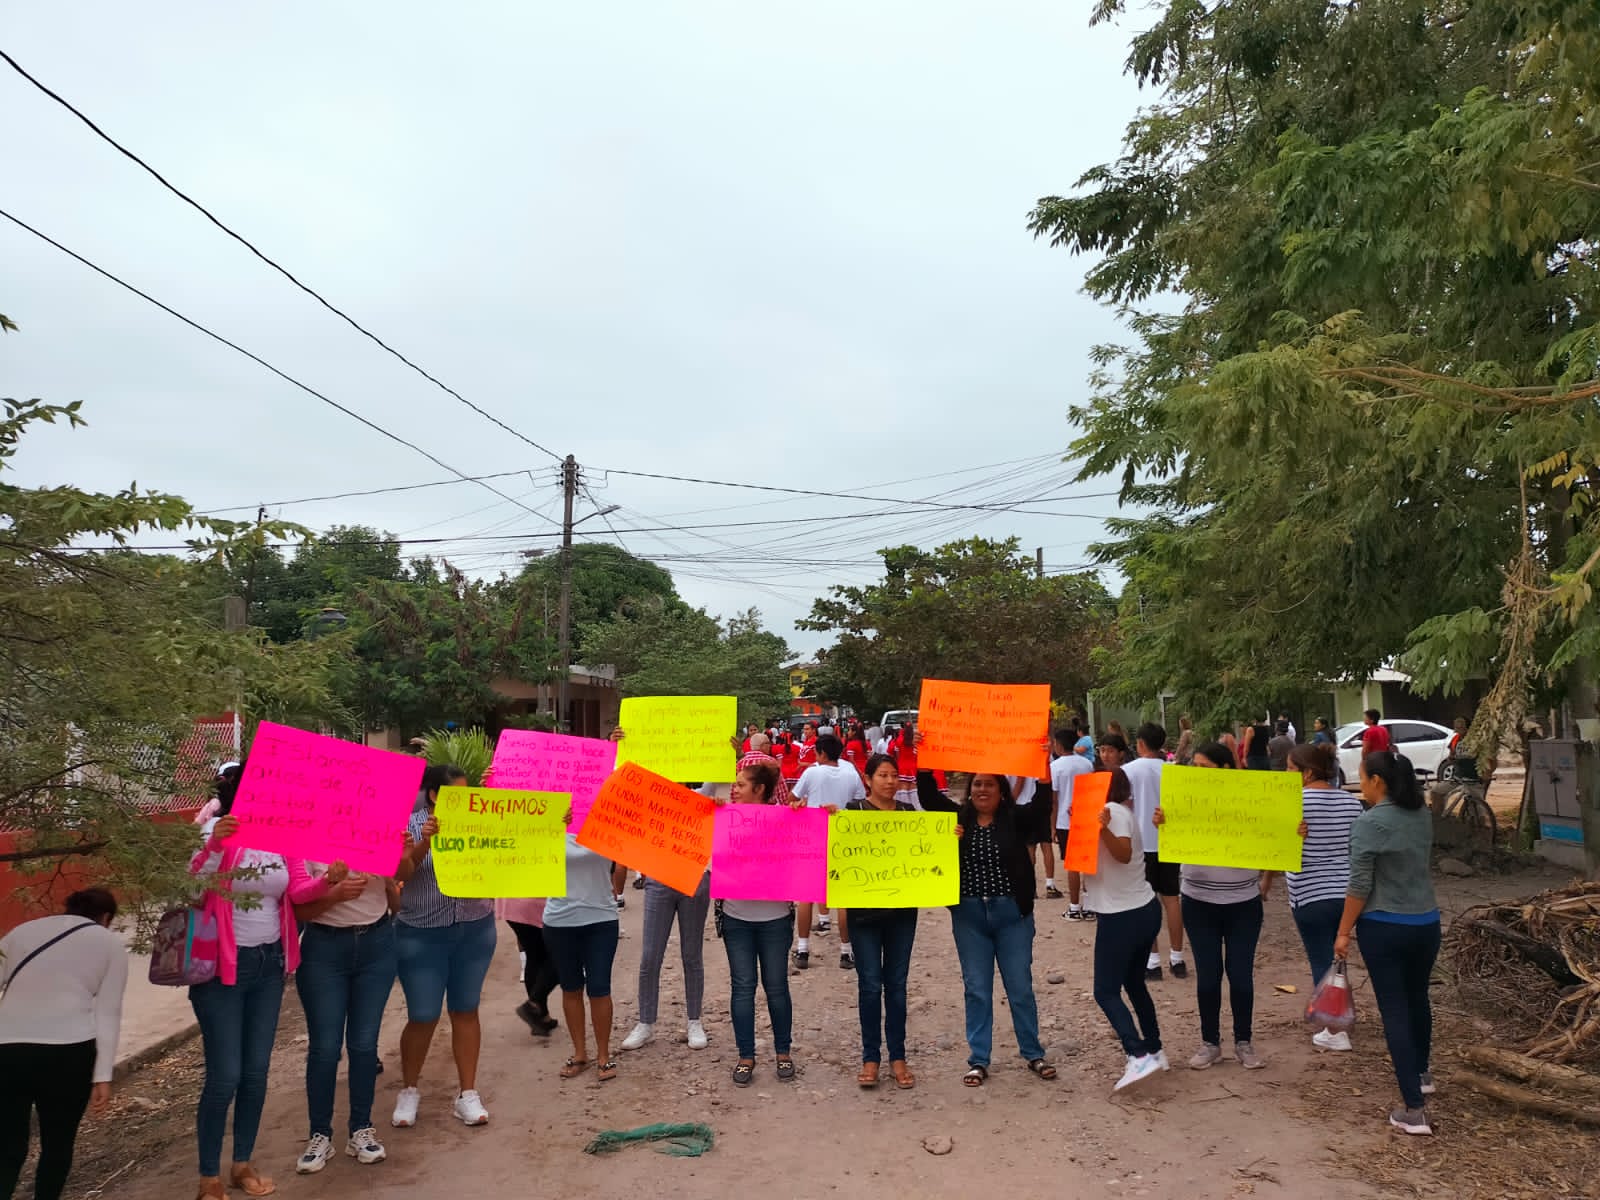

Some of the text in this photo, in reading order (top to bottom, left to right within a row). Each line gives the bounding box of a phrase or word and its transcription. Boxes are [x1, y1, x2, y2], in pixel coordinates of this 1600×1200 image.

[468, 792, 549, 821] EXIGIMOS
[835, 815, 928, 835] Queremos
[935, 815, 951, 834] el
[434, 834, 466, 853] LUCIO
[910, 837, 936, 857] de
[841, 864, 928, 887] Director
